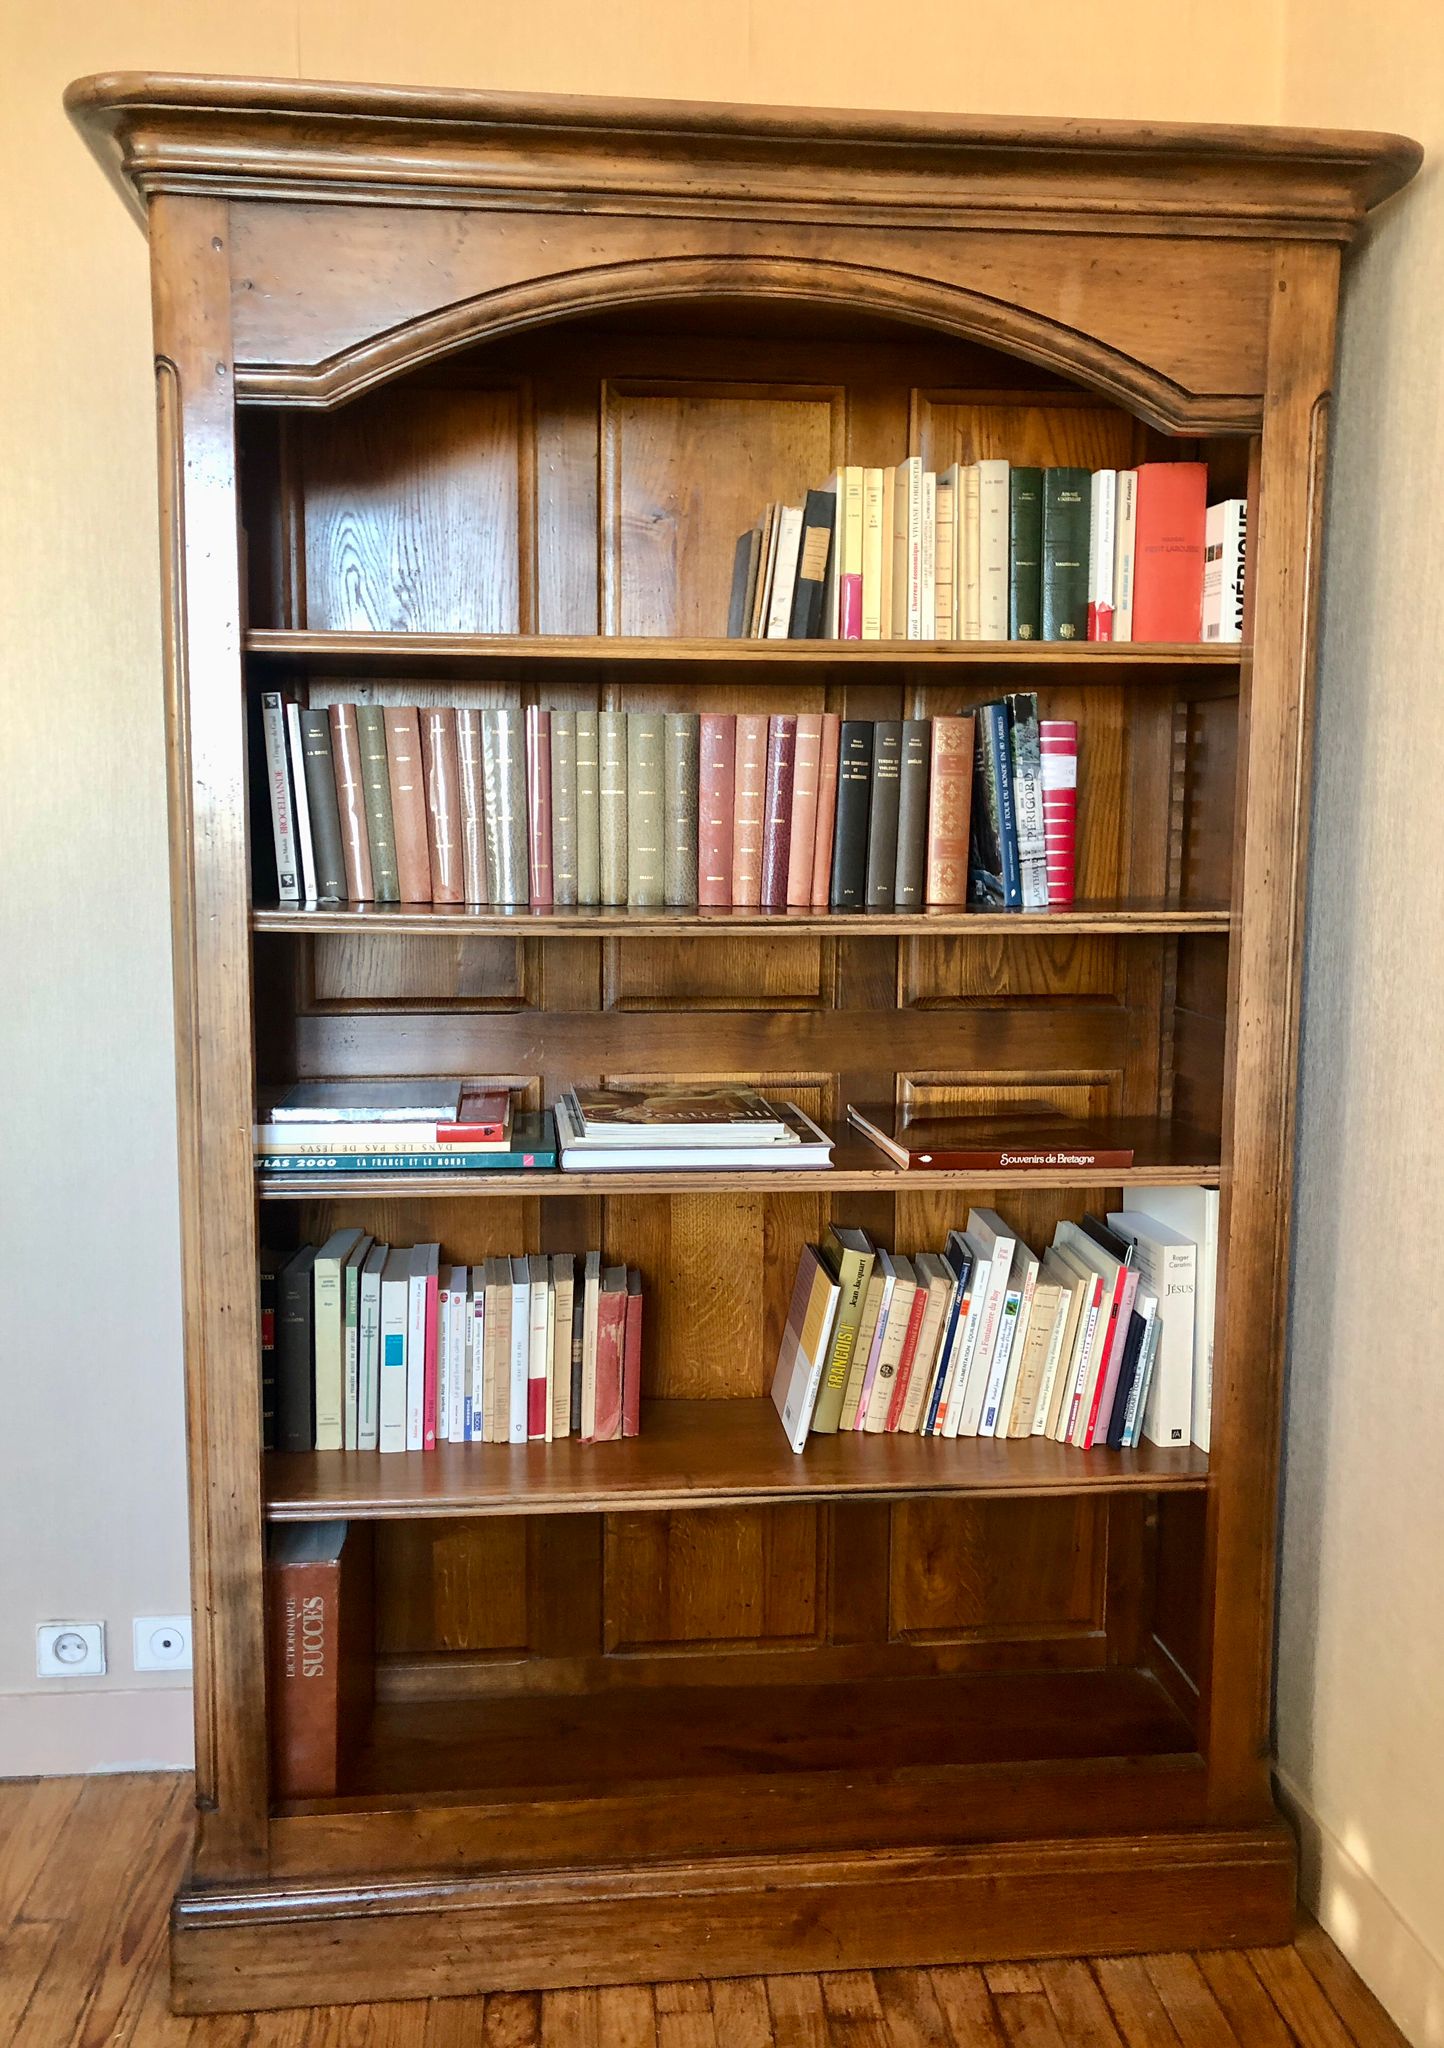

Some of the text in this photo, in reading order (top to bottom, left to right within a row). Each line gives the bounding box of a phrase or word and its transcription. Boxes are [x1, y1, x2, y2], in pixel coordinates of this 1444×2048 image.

[912, 459, 920, 505] FORRESTER
[911, 507, 920, 538] VIVIANE
[1000, 752, 1007, 761] EN
[1001, 763, 1009, 788] MONDE
[1003, 789, 1010, 800] DU
[1023, 772, 1037, 840] PÉRIGORD
[1005, 822, 1012, 830] LE
[343, 1144, 357, 1152] DE
[366, 1143, 386, 1152] PAS
[394, 1143, 414, 1152] LES
[295, 1159, 337, 1167] 2000
[356, 1157, 467, 1167] LA FRANCE ET LE MONDE
[1000, 1153, 1095, 1166] Souvenirs de Bretagne
[1172, 1254, 1189, 1262] Roger
[848, 1259, 866, 1308] Jean Jacquart
[1165, 1283, 1194, 1297] JÉSUS
[990, 1289, 1001, 1302] Roy
[988, 1302, 997, 1311] du
[979, 1347, 988, 1356] La
[958, 1345, 971, 1387] L'ALIMENTATION
[1131, 1371, 1142, 1393] TOLLE
[473, 1412, 482, 1431] POCKET
[285, 1597, 297, 1678] DICTIONNAIRE
[296, 1596, 324, 1678] SUCCÈS
